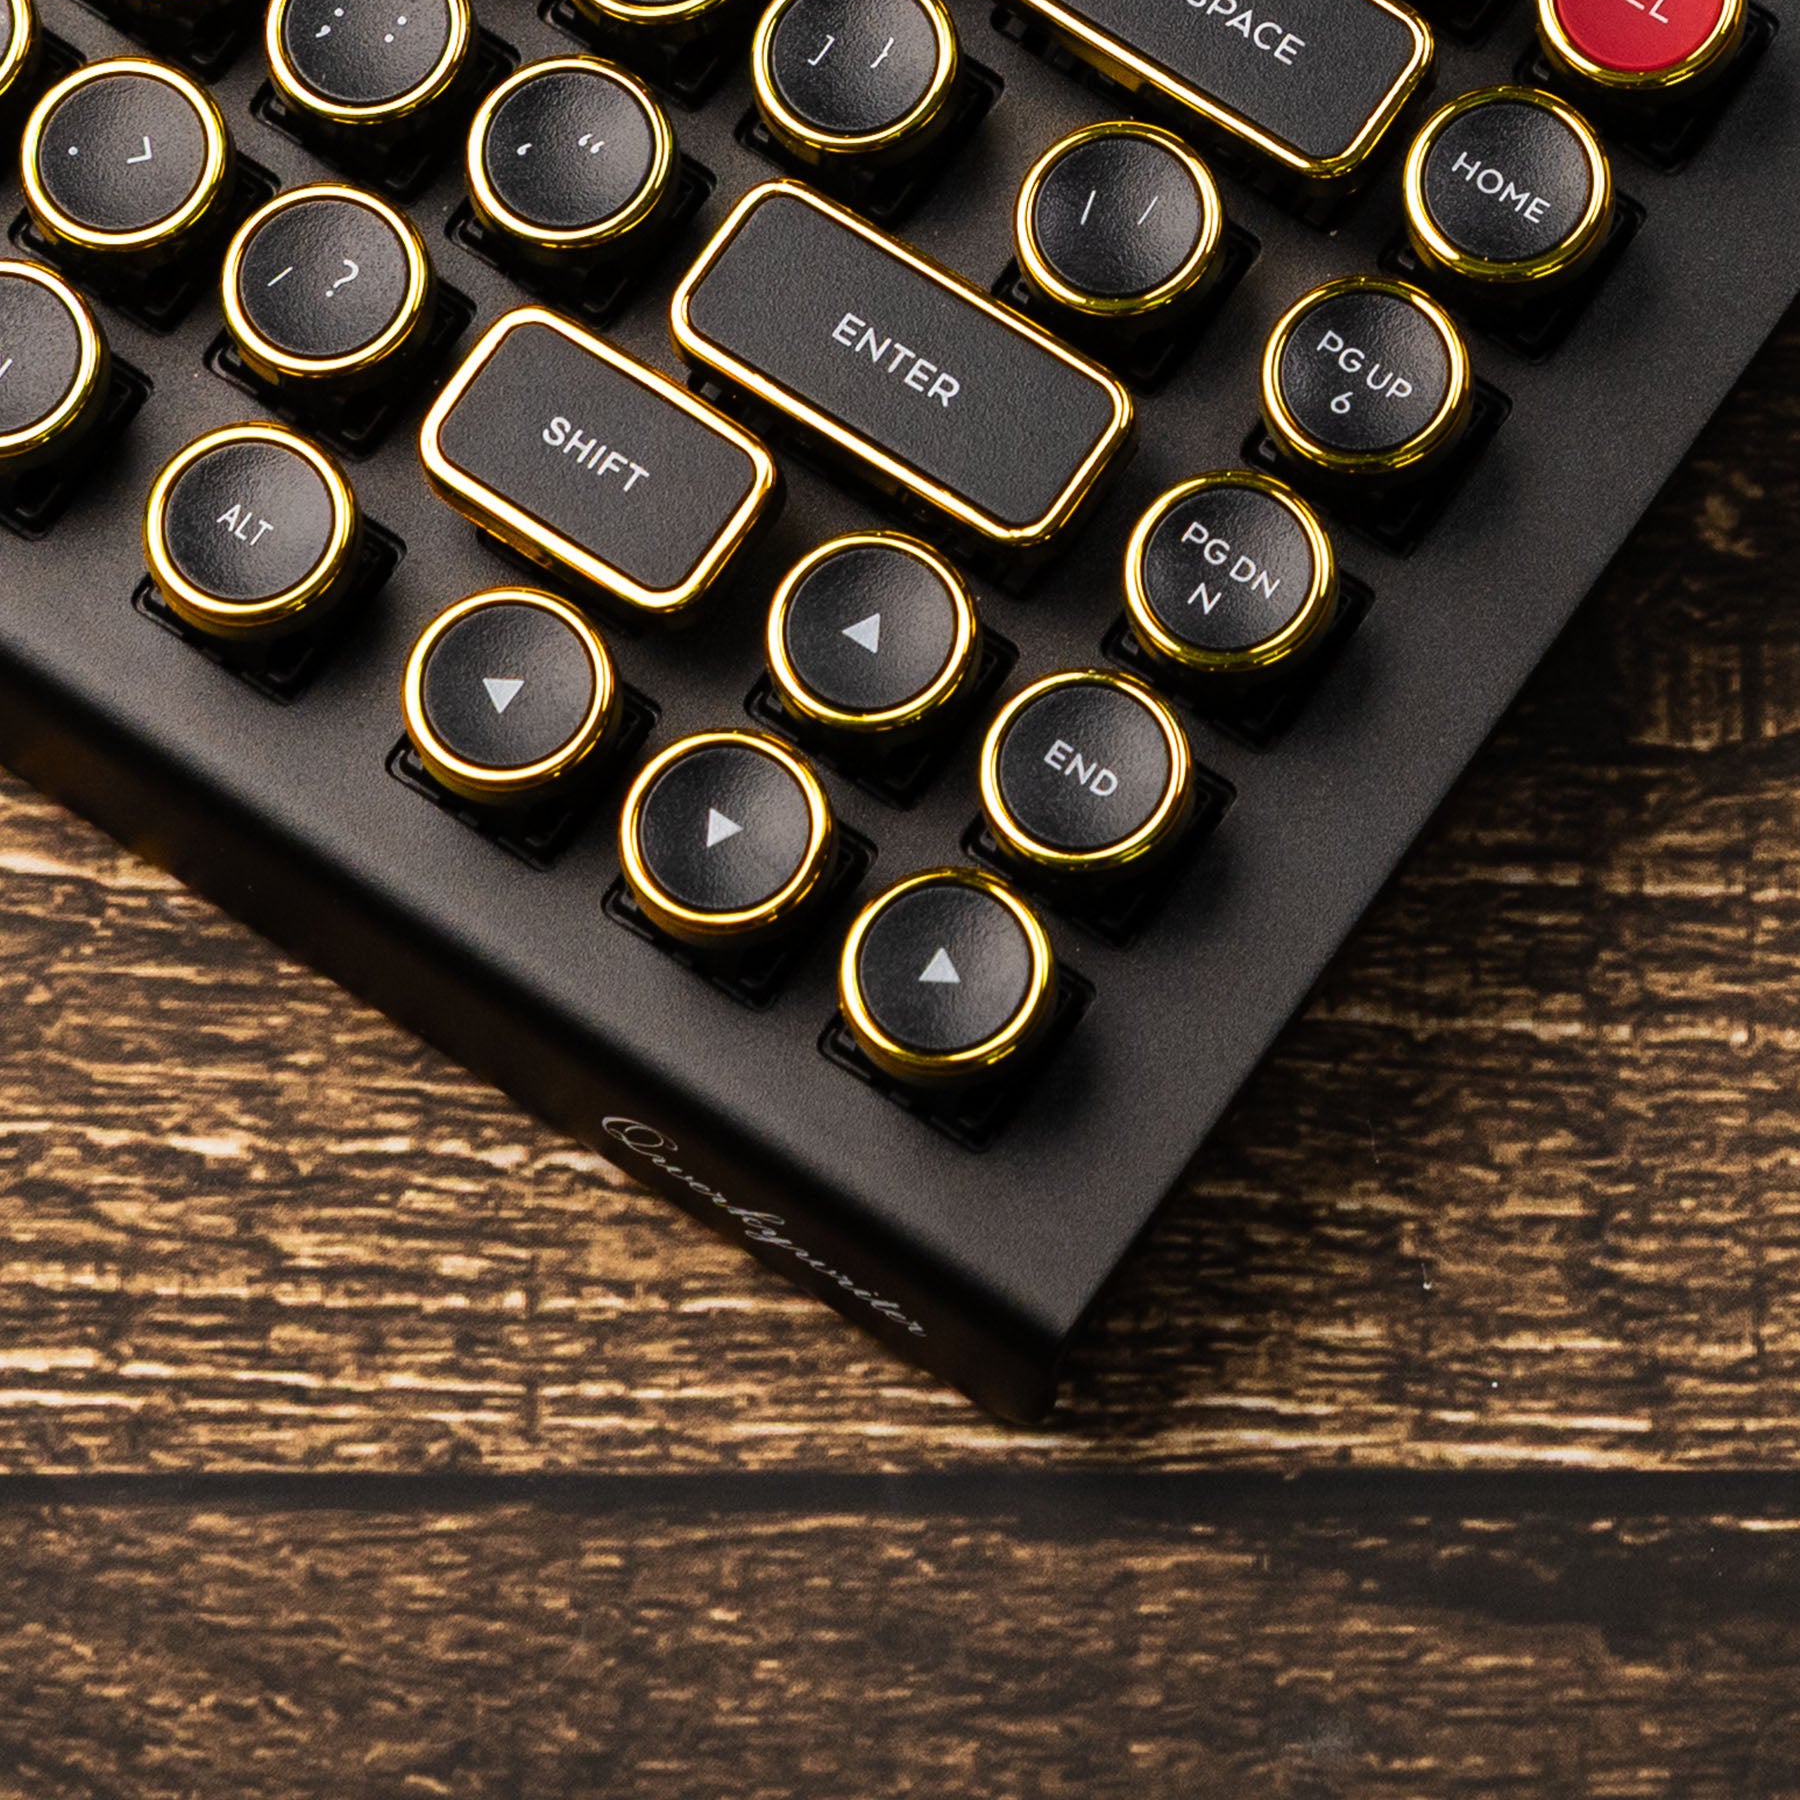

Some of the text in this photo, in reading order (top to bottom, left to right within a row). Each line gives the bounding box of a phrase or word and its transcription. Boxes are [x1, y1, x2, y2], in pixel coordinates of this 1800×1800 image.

[1451, 151, 1551, 224] HOME
[325, 258, 359, 298] ?
[831, 312, 960, 407] ENTER
[1316, 330, 1413, 398] PG UP
[1330, 391, 1353, 414] 6
[542, 416, 650, 492] SHIFT
[216, 503, 274, 546] ALT
[1181, 521, 1281, 599] PG DN
[1187, 582, 1222, 615] N
[1044, 739, 1119, 797] END
